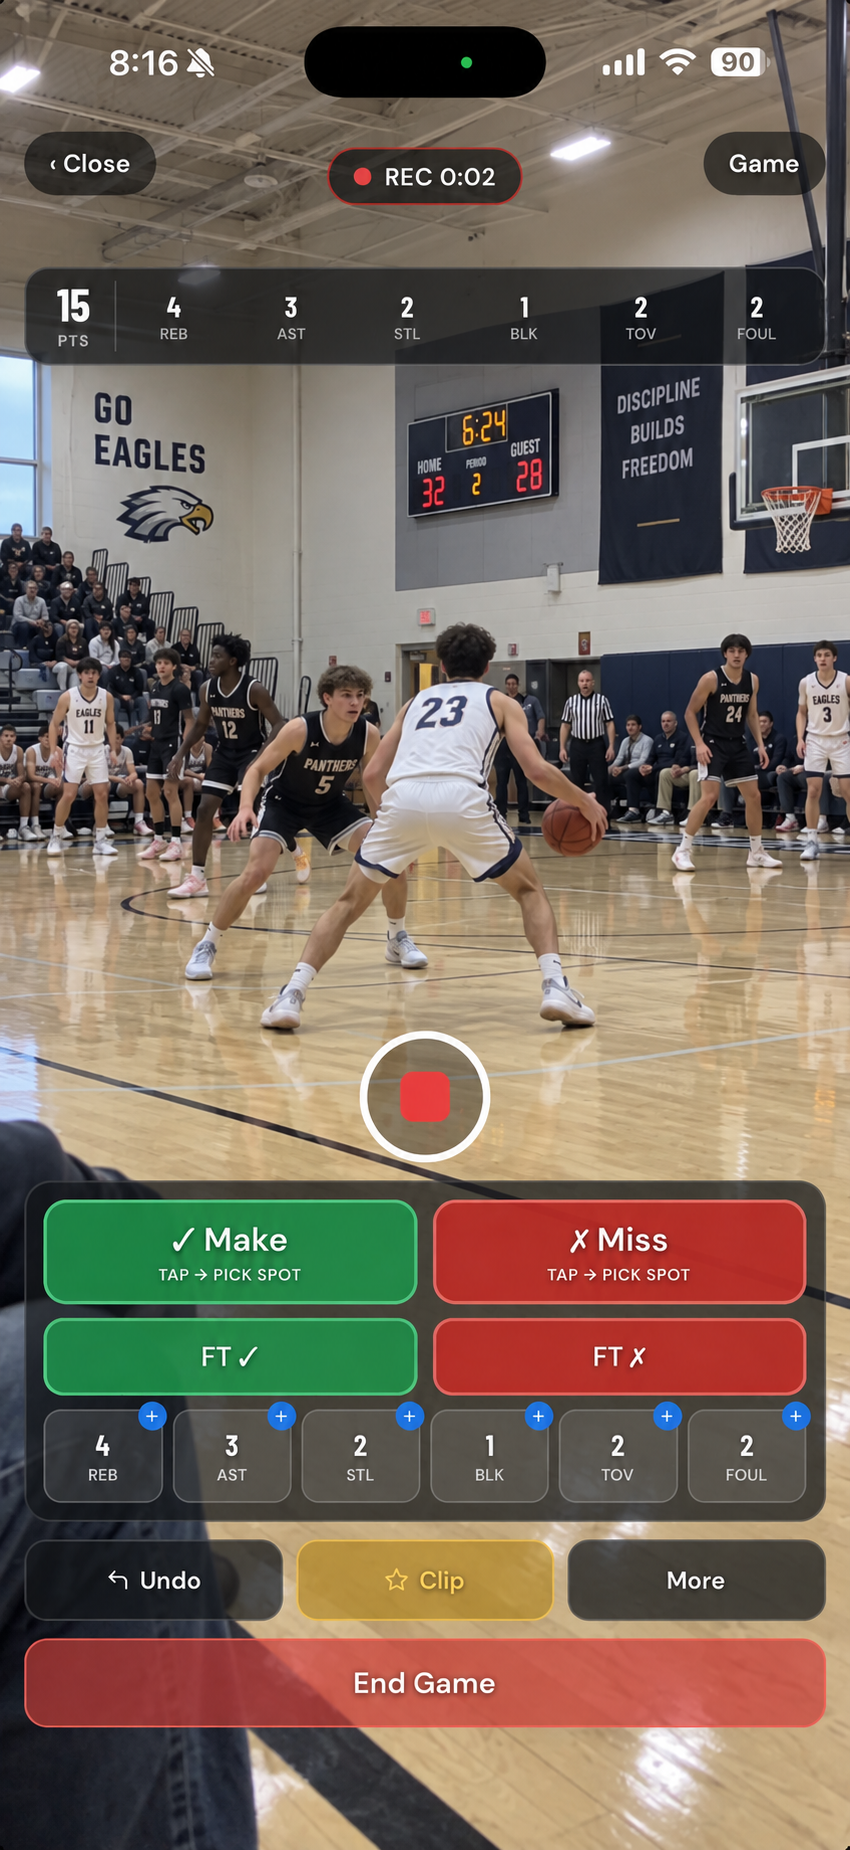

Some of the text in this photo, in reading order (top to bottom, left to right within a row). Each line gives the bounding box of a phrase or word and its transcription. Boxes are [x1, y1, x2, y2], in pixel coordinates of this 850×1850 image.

[617, 376, 701, 414] DISCIPLINE
[94, 391, 132, 426] GO
[462, 409, 506, 445] 6:24
[630, 414, 685, 444] BUILDS
[94, 433, 206, 475] EAGLES
[510, 438, 541, 457] GUEST
[417, 457, 442, 475] HOME
[622, 447, 693, 479] FREEDOM
[472, 472, 481, 495] 2
[516, 458, 543, 493] 28
[422, 475, 445, 508] 32
[720, 693, 750, 704] PANTHERS
[812, 694, 840, 706] EAGLES
[75, 708, 102, 718] EAGLES
[211, 706, 246, 719] PANTHERS
[415, 695, 469, 731] 23
[725, 705, 743, 724] 24
[823, 706, 832, 723] 3
[84, 719, 94, 734] 11
[221, 720, 238, 739] 12
[303, 757, 358, 772] PANTHERS
[314, 775, 335, 795] 5
